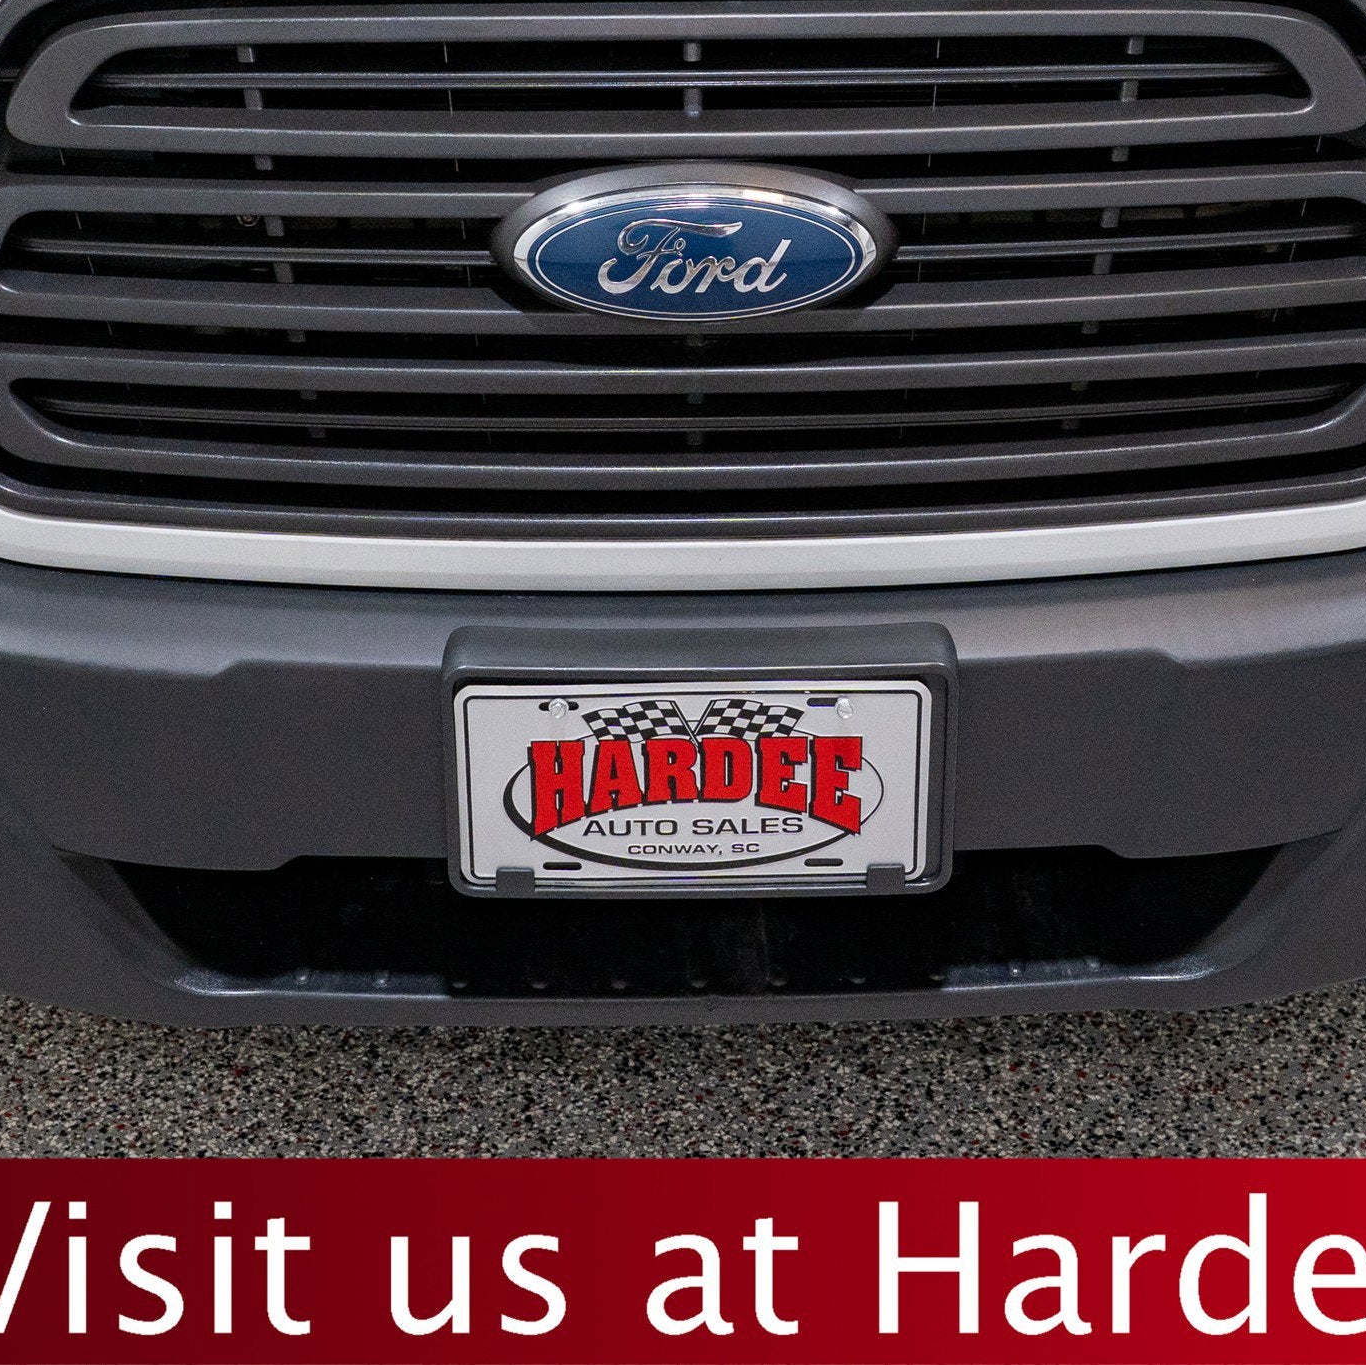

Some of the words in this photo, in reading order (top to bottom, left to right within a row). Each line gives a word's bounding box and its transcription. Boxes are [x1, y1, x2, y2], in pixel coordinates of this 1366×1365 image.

[597, 218, 792, 294] Ford
[527, 735, 863, 839] HARDEE
[582, 819, 679, 837] AUTO
[691, 816, 804, 836] SALES
[627, 843, 724, 856] CONWAY,
[731, 842, 761, 854] SC
